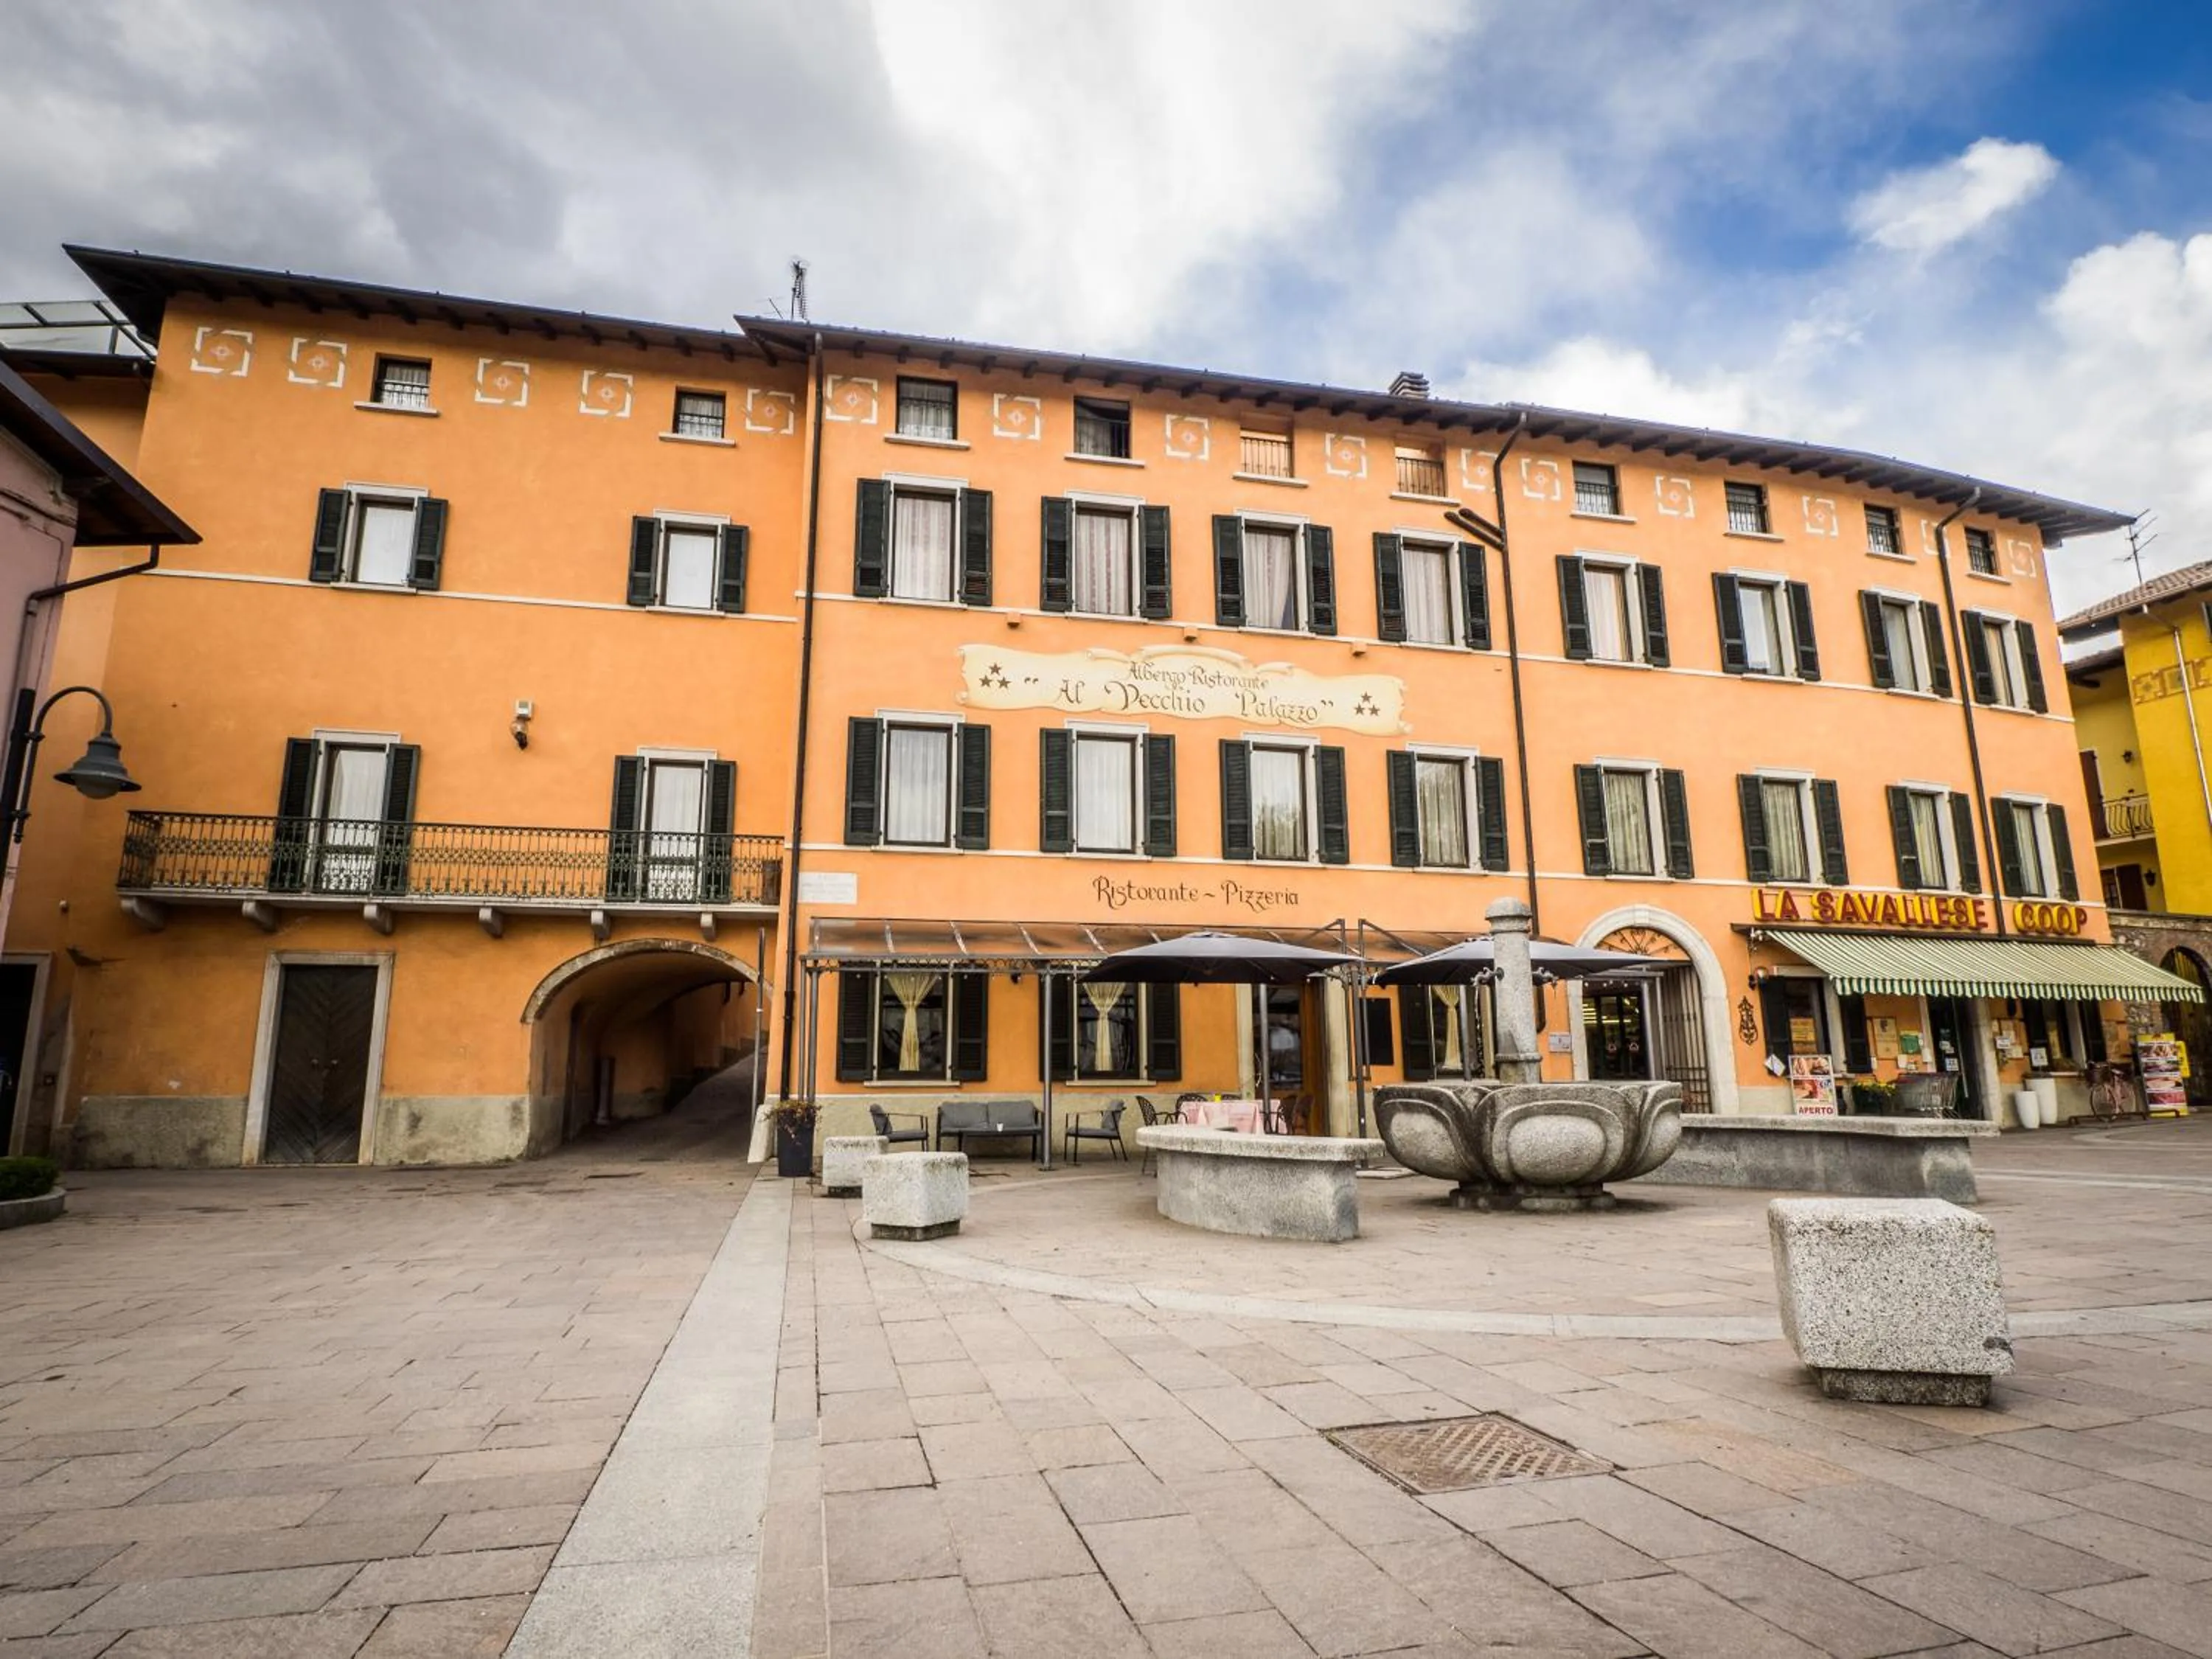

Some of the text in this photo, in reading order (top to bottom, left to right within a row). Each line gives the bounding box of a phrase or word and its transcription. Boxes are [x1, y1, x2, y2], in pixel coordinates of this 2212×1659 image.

[1128, 661, 1269, 690] Albergo Ristorante
[1104, 680, 1206, 713] Vecchio
[1092, 874, 1199, 911] Ristorante
[1220, 879, 1299, 914] Pizzeria
[1751, 888, 2088, 936] LA SAVALLESE COOP
[1798, 1107, 1834, 1115] APERTO
